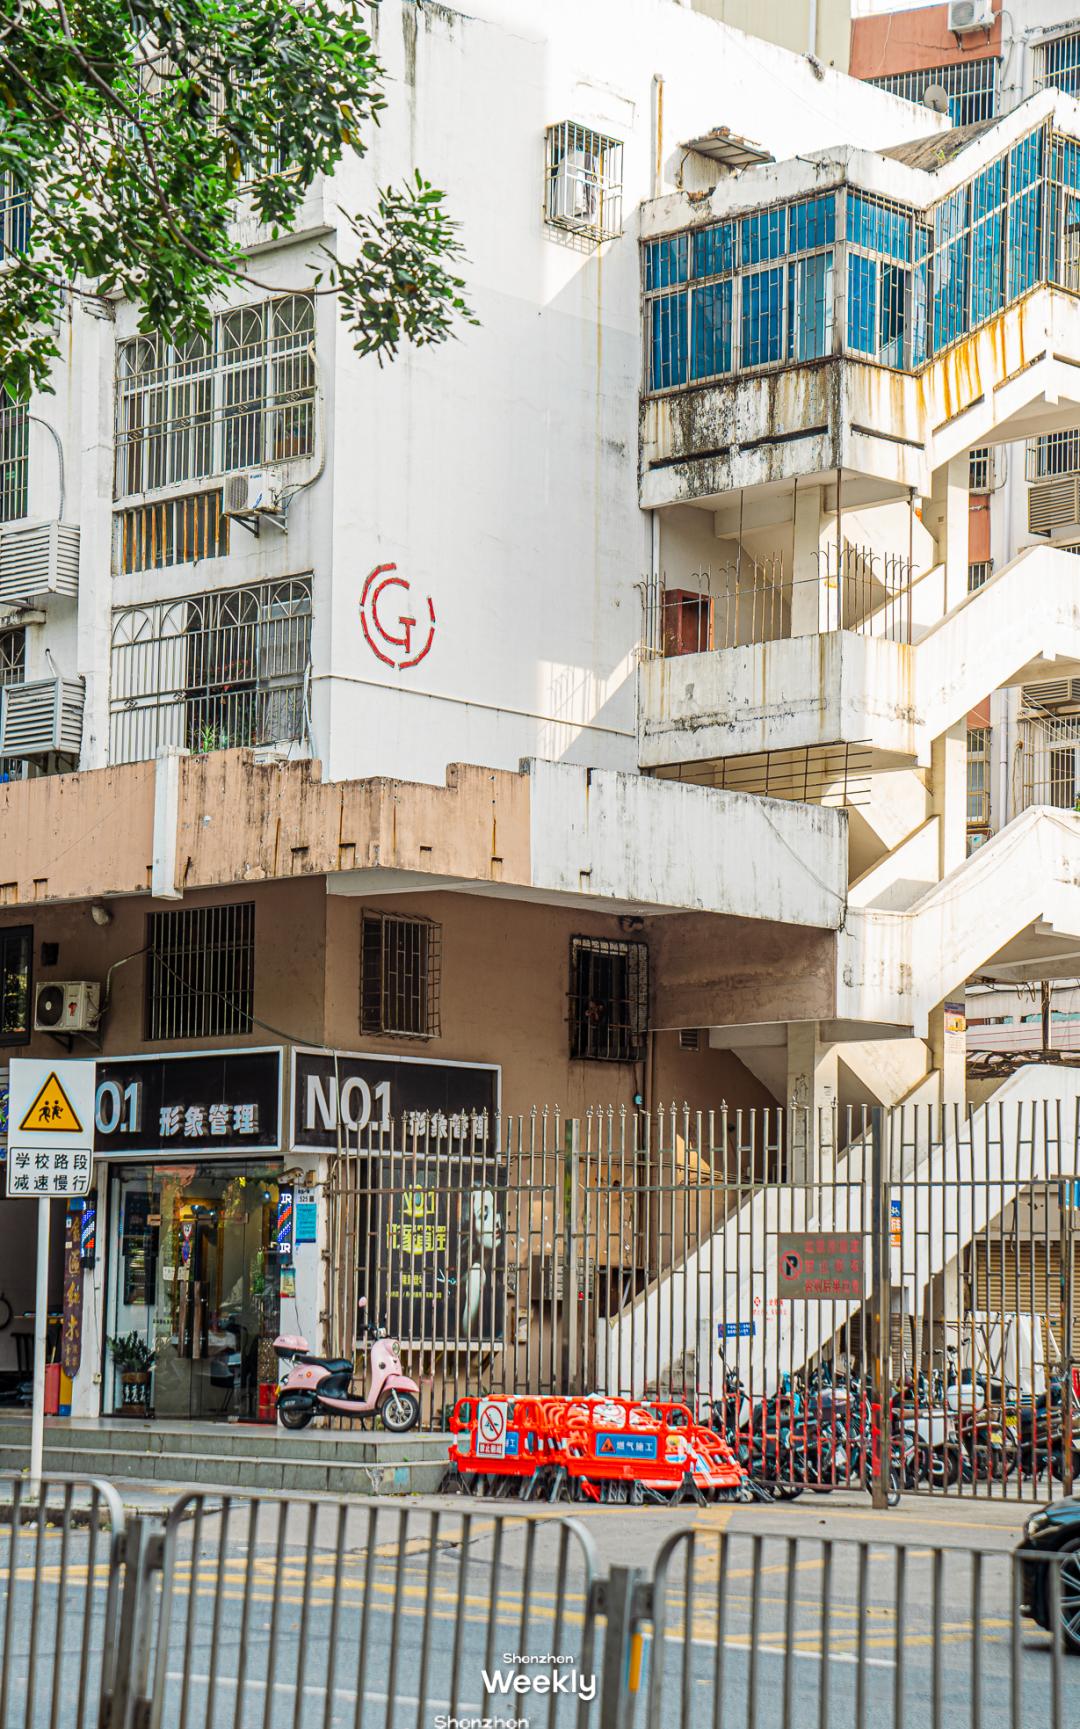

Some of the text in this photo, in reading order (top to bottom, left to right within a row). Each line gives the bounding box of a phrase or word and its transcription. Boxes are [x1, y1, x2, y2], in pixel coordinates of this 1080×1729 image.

[159, 1104, 258, 1137] 形象管理
[15, 1152, 88, 1170] 学校路段
[14, 1173, 87, 1191] 减速慢行
